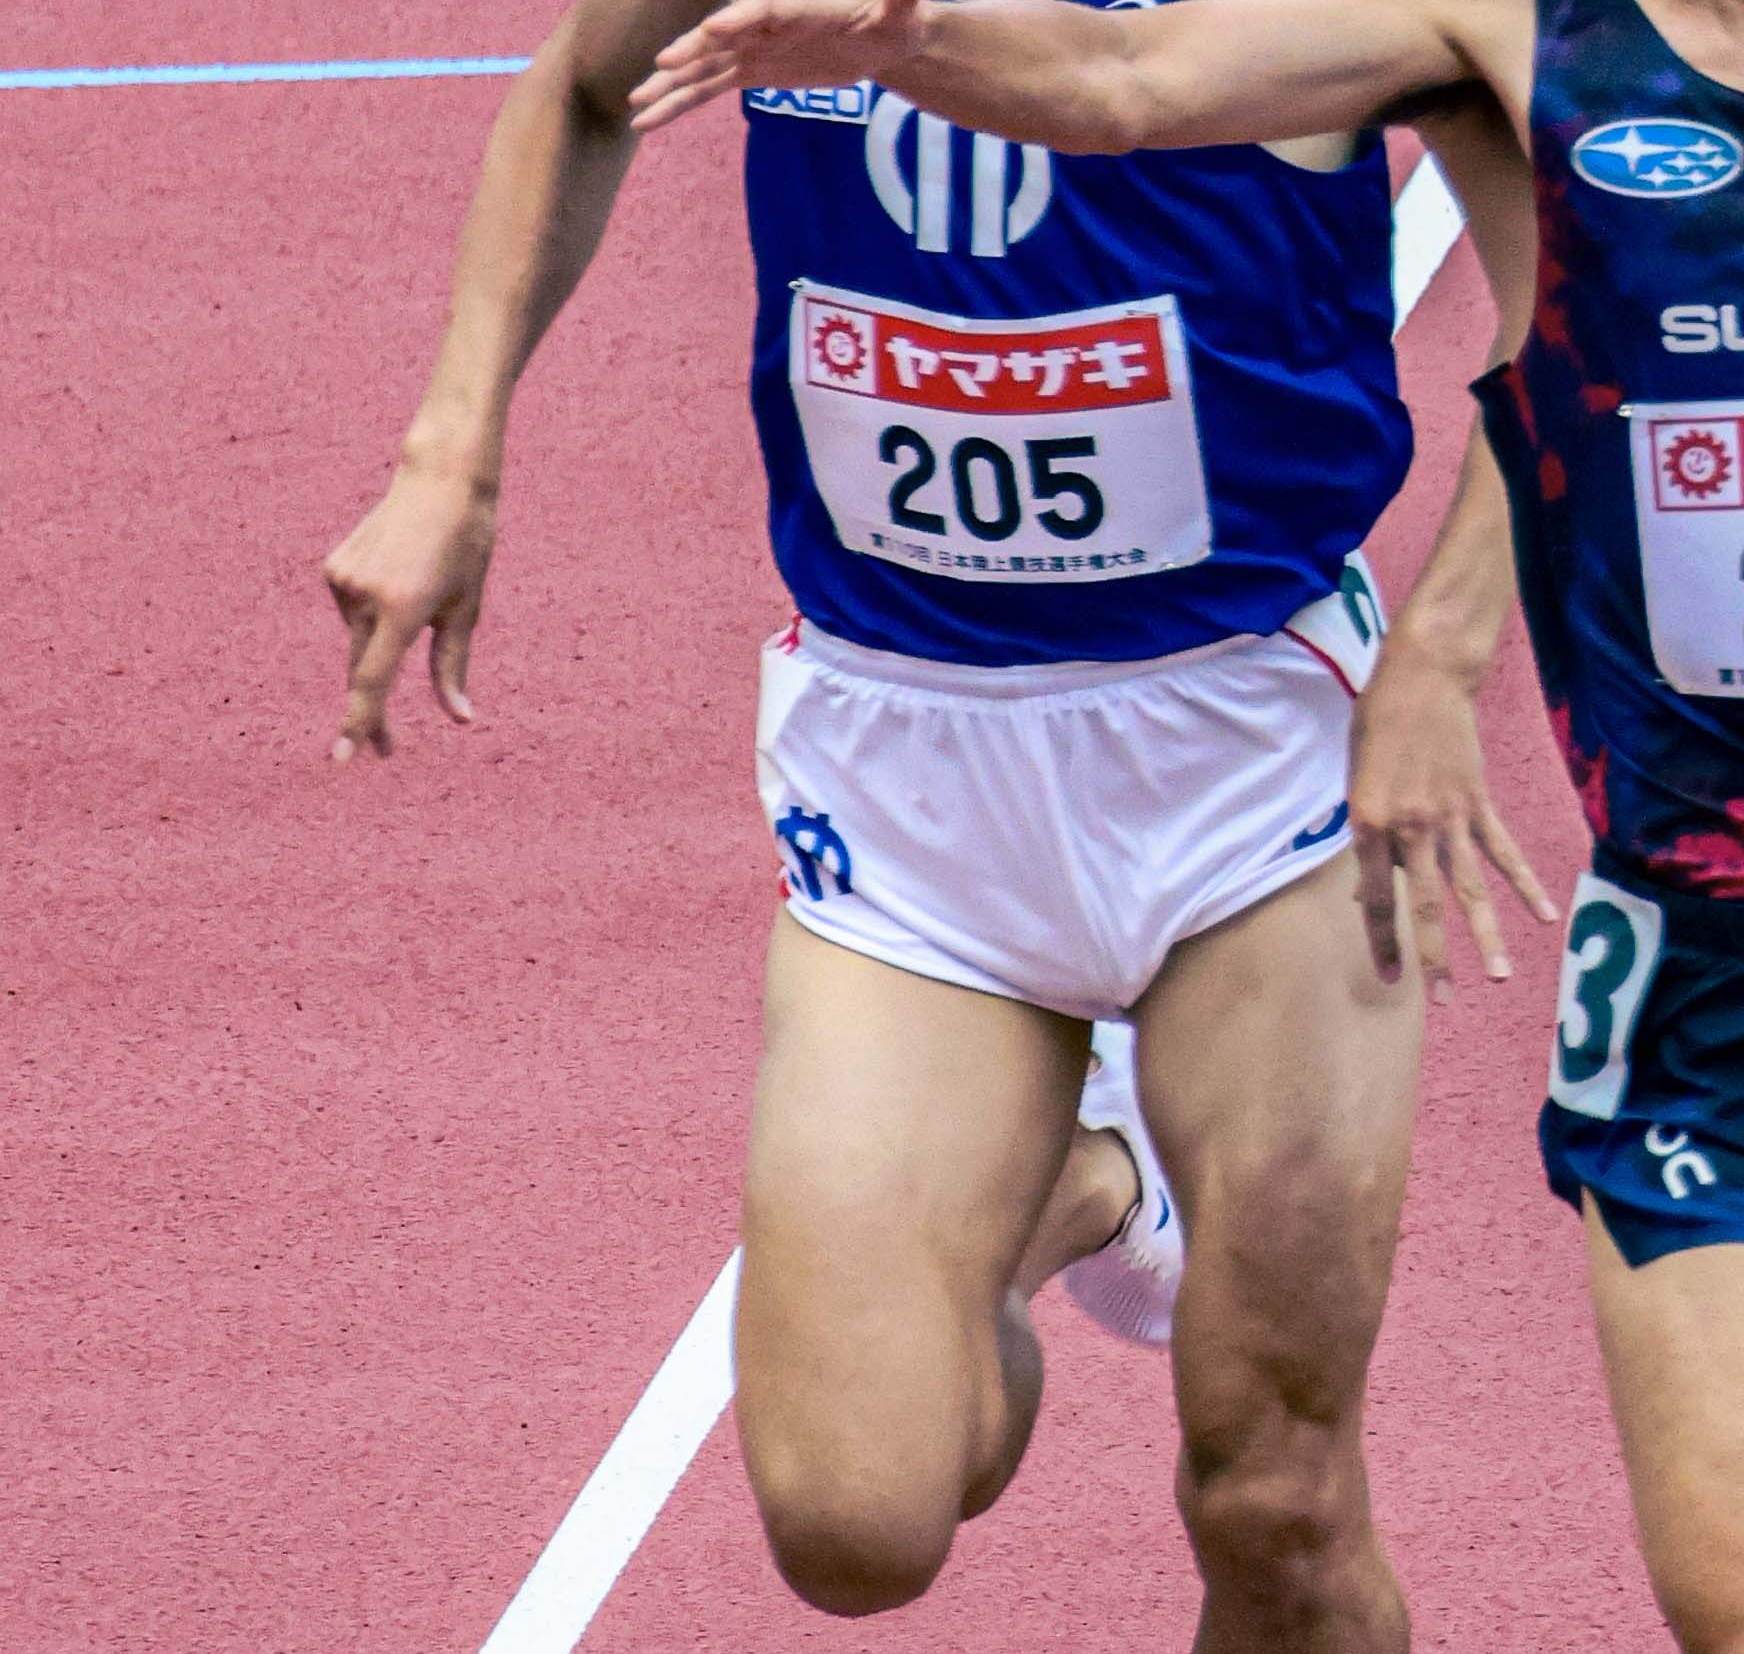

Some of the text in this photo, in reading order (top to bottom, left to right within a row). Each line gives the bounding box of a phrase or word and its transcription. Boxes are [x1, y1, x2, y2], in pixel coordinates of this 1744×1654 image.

[885, 336, 1147, 398] ヤマザキ
[879, 425, 1103, 541] 205
[1558, 900, 1636, 1084] 3
